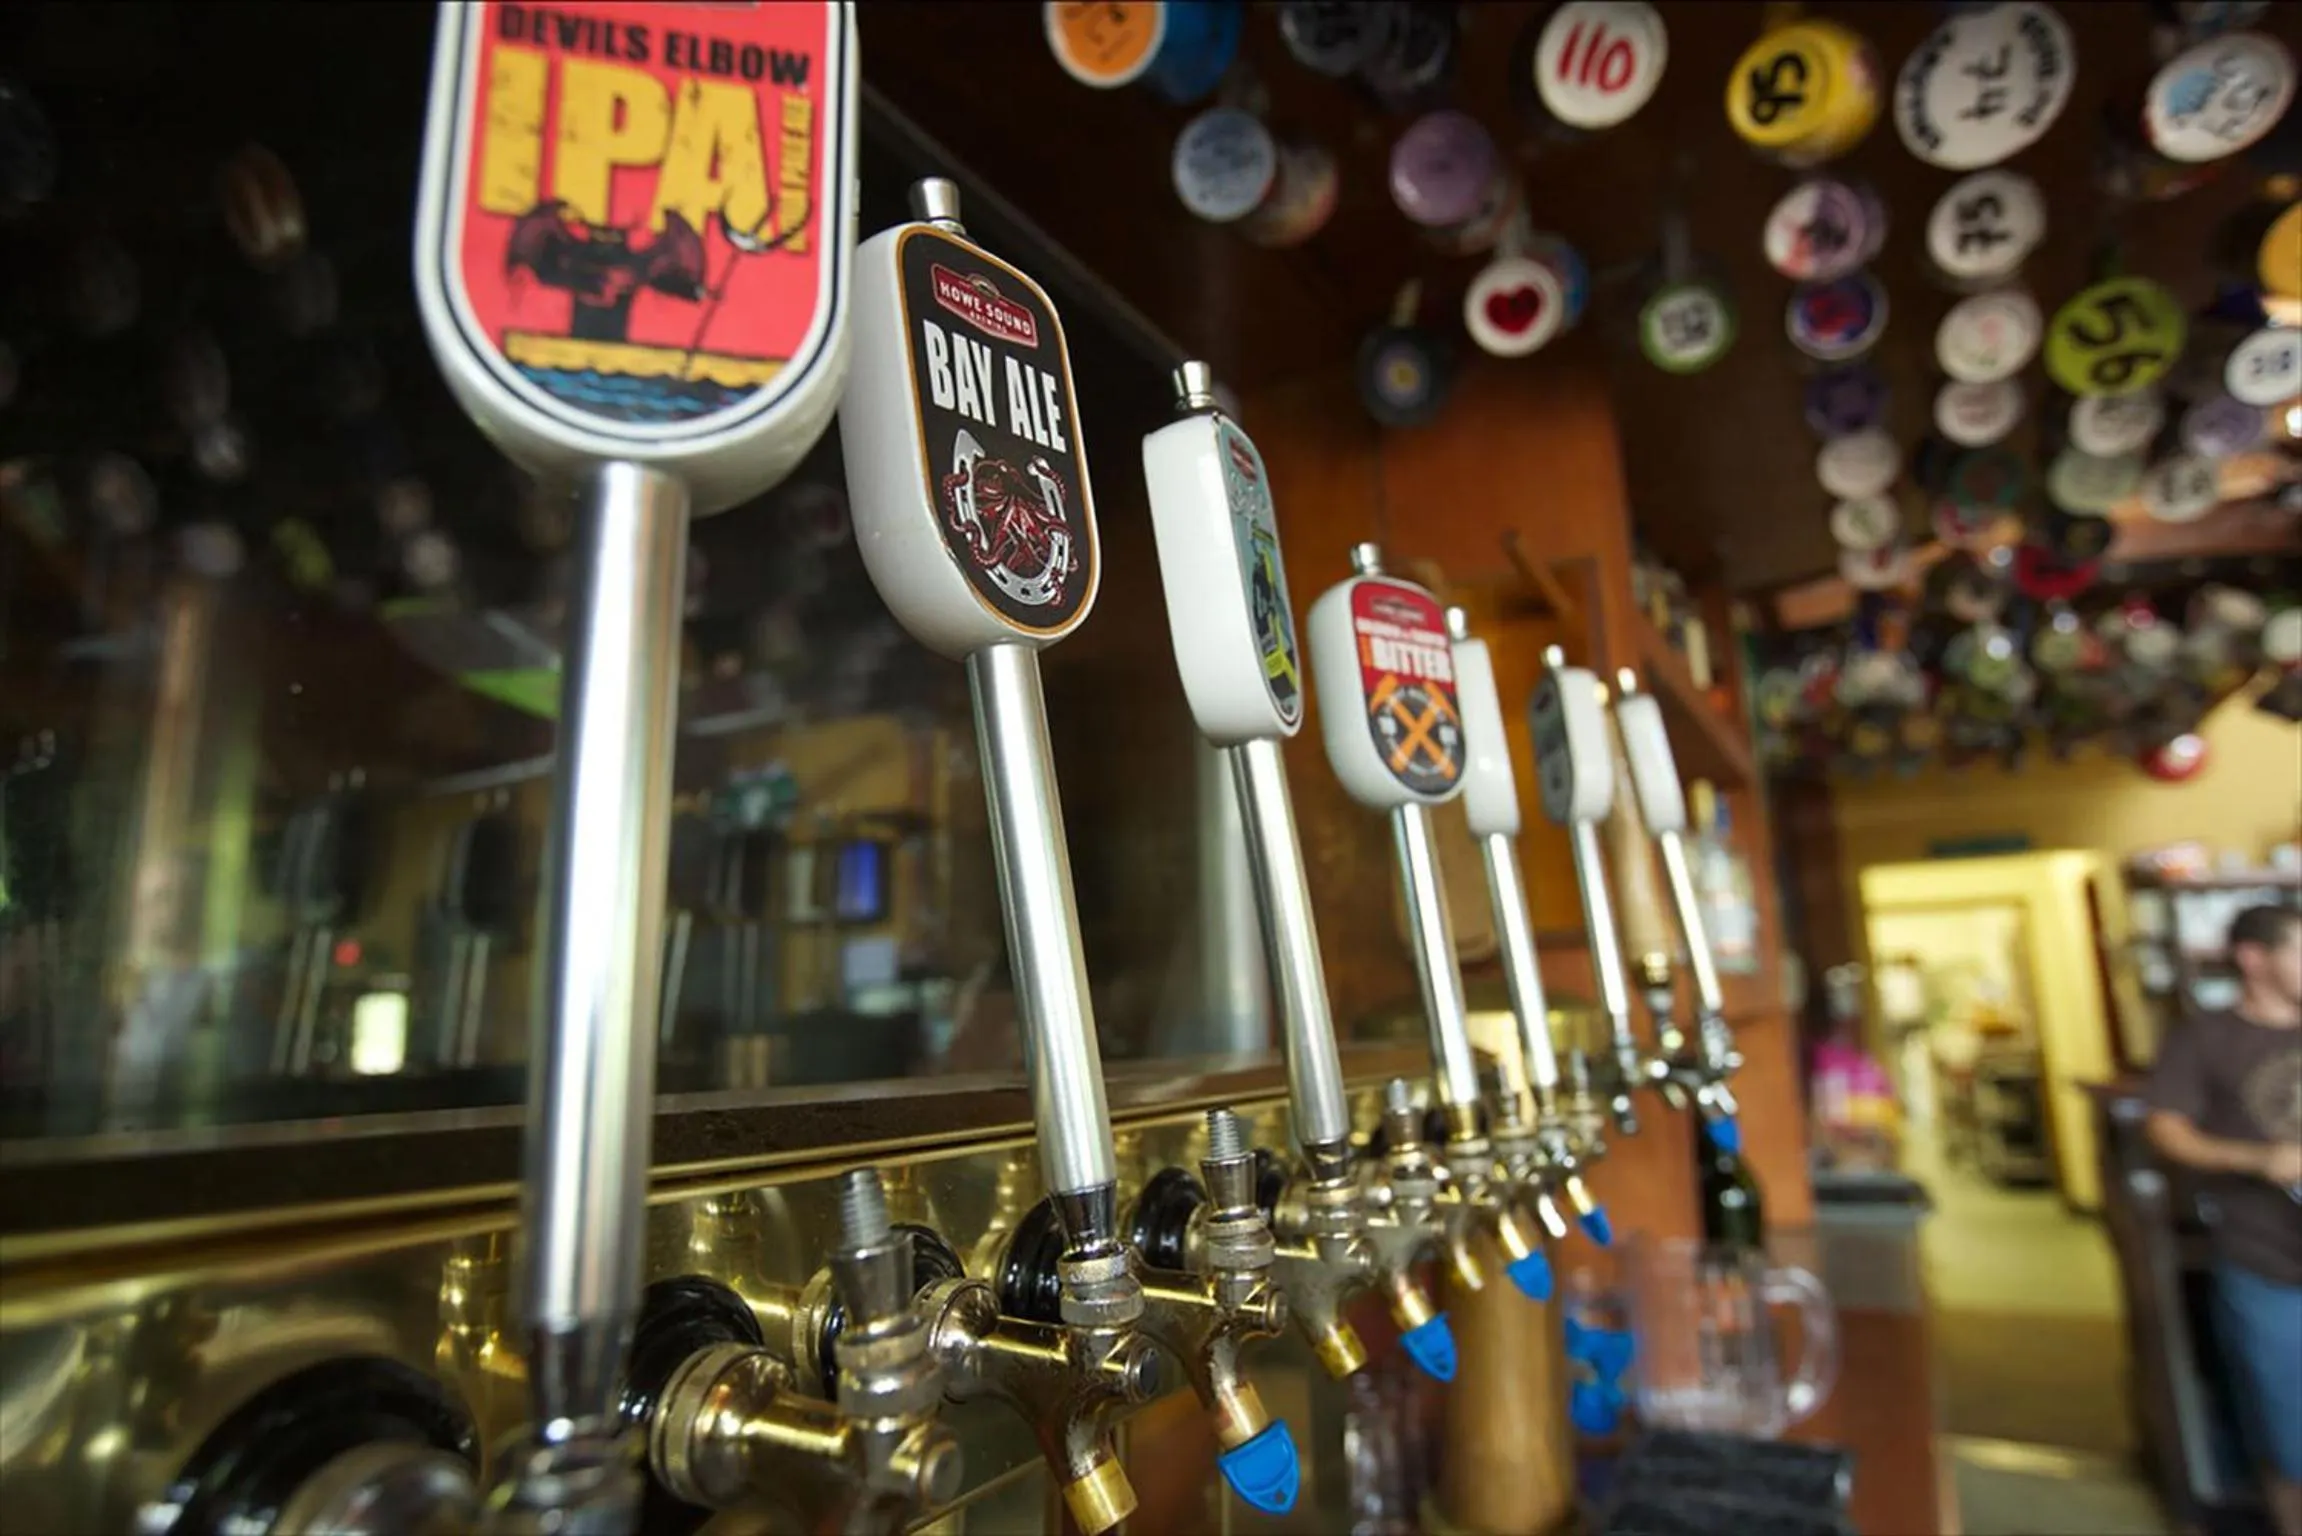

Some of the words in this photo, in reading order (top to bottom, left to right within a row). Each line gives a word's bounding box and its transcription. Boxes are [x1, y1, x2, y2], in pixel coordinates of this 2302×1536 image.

[497, 3, 650, 62] DEVILS
[664, 30, 810, 86] ELBOW
[1556, 20, 1636, 94] 110
[1750, 52, 1807, 126] 95
[984, 303, 1032, 336] SOUND
[923, 319, 996, 428] BAY
[1004, 355, 1067, 453] ALE
